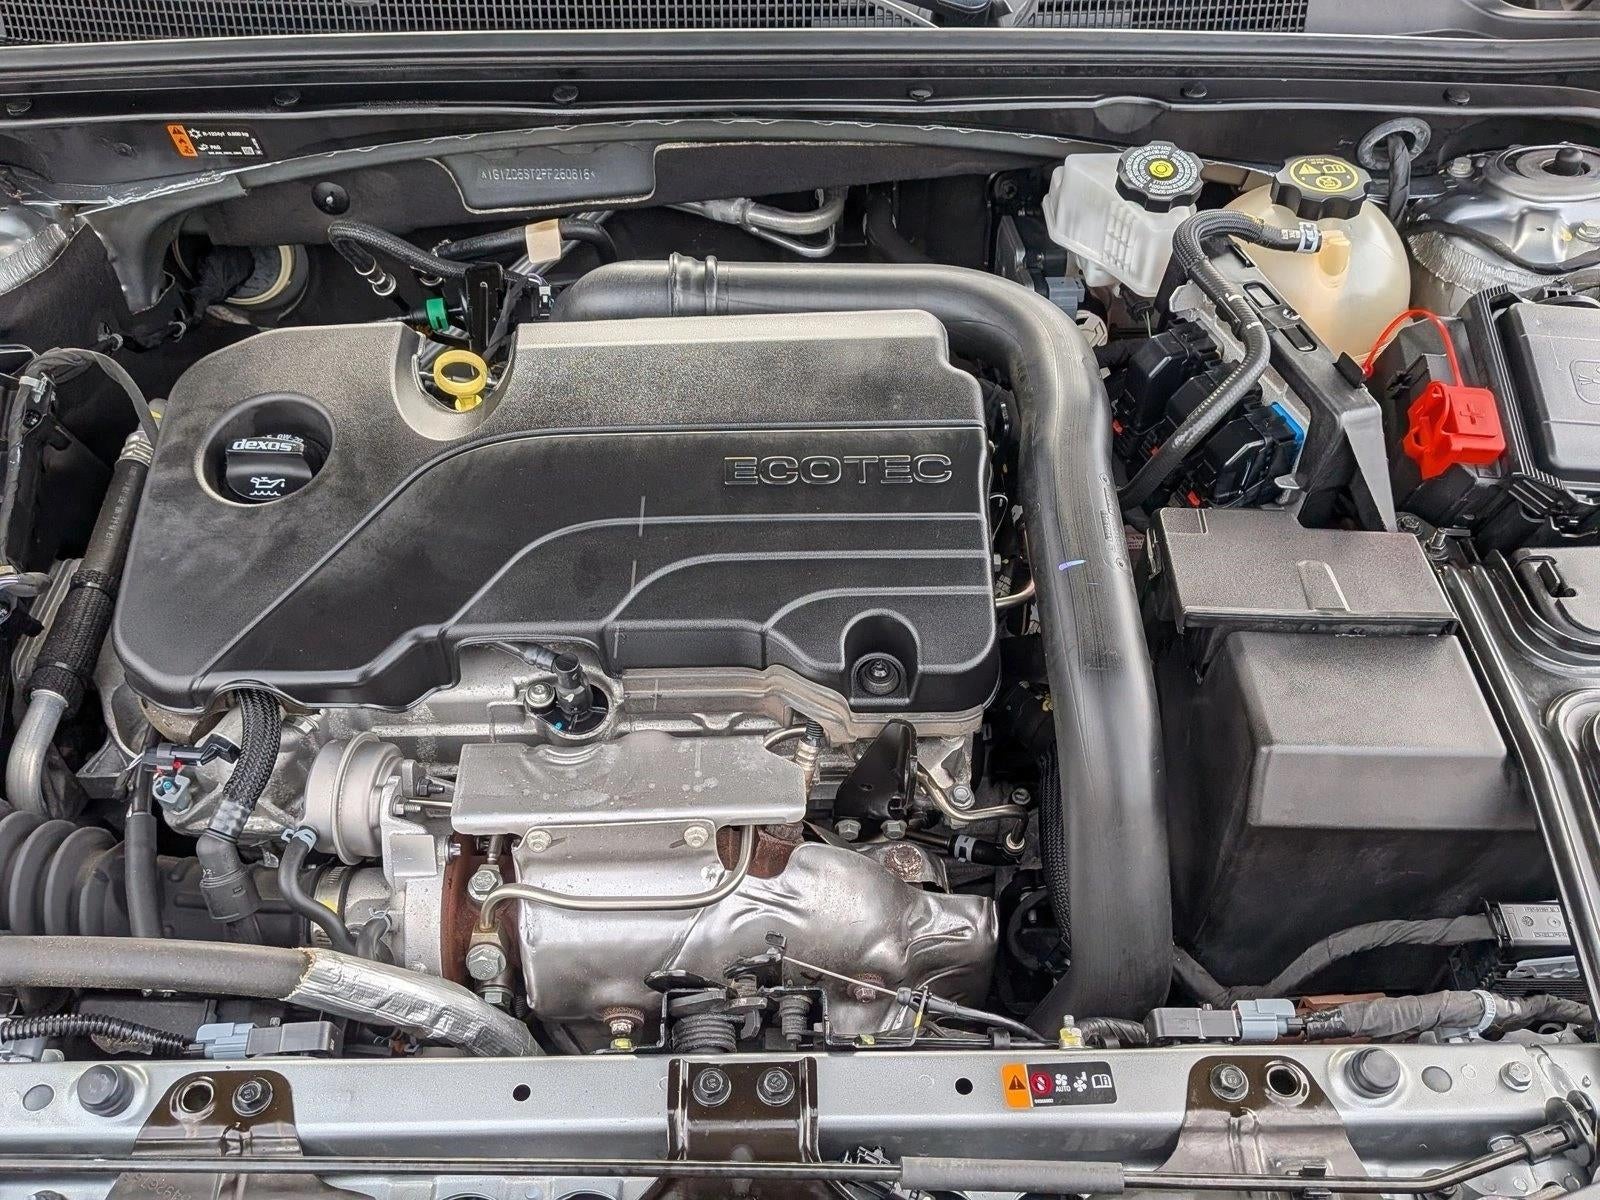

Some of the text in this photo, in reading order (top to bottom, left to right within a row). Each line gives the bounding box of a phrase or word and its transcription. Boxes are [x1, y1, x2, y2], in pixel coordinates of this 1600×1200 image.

[232, 438, 295, 452] dexos
[724, 454, 953, 485] ECOTEC
[1055, 1085, 1071, 1093] AUTO
